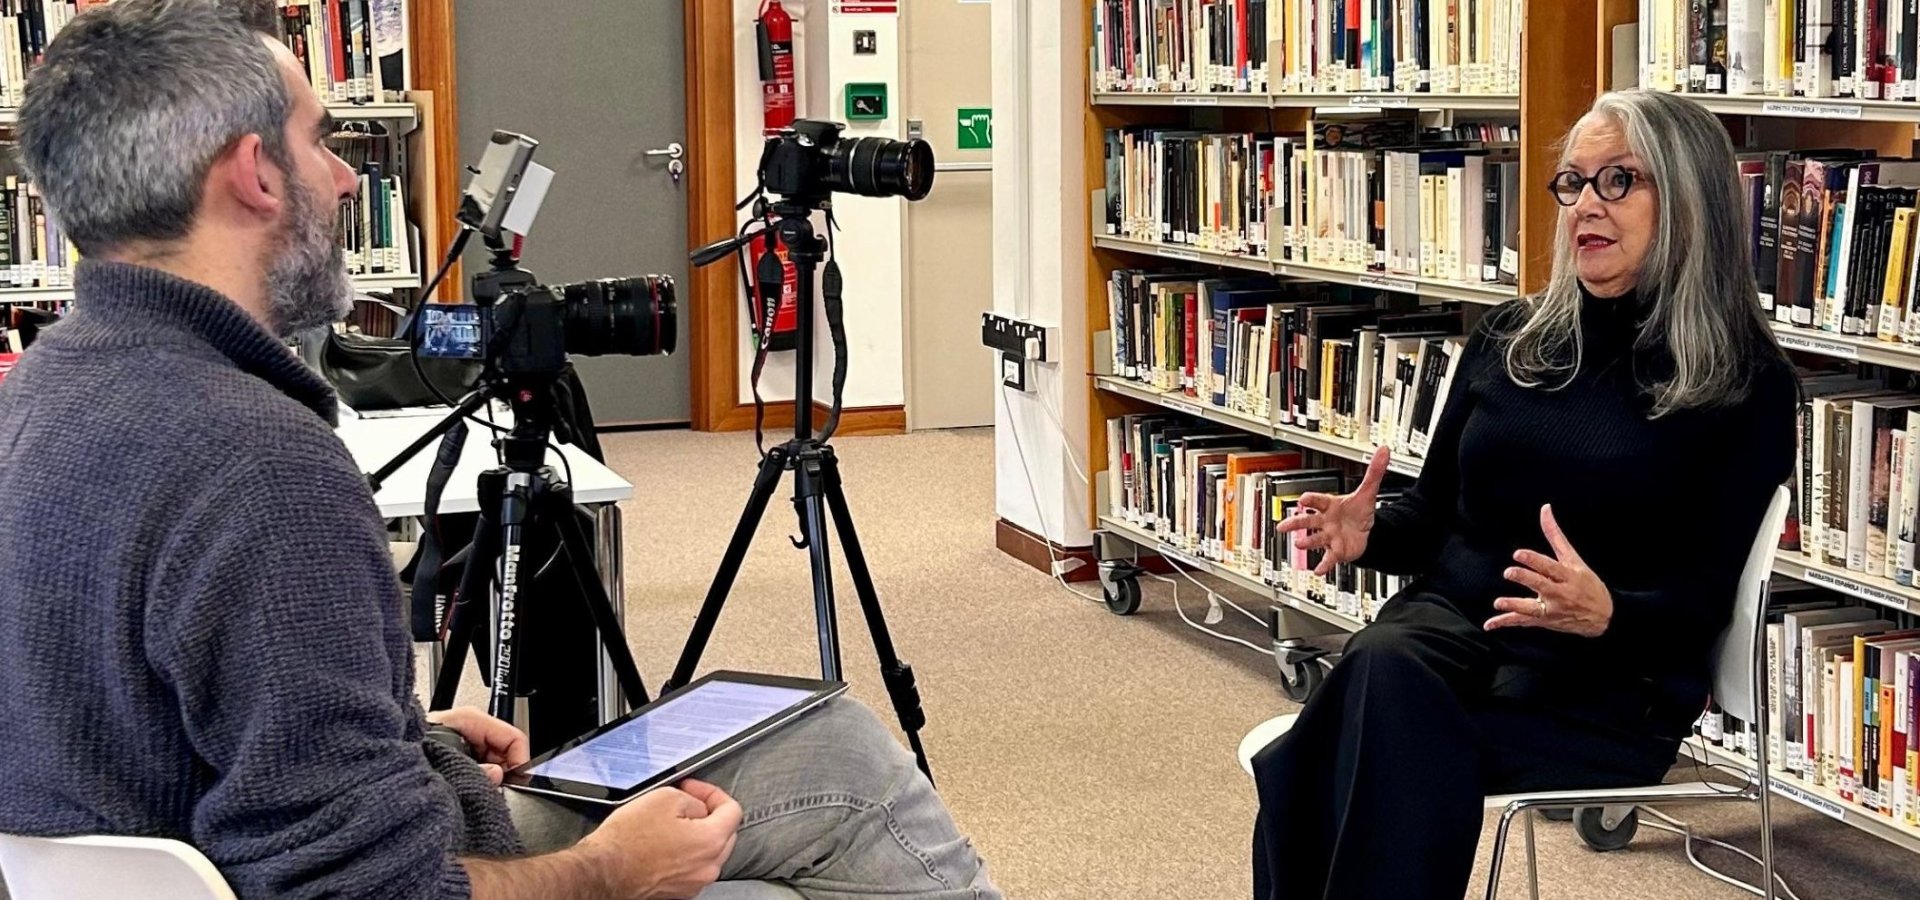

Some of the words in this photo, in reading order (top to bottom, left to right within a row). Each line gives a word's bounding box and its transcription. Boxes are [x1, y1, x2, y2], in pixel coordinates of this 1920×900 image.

[761, 297, 776, 350] Canon
[498, 544, 521, 640] Manfrotto
[1834, 578, 1859, 591] ESPAÑOLA
[1775, 781, 1799, 797] ESPAÑOLA
[1802, 793, 1823, 806] SPANISH
[1822, 801, 1842, 814] FICTION
